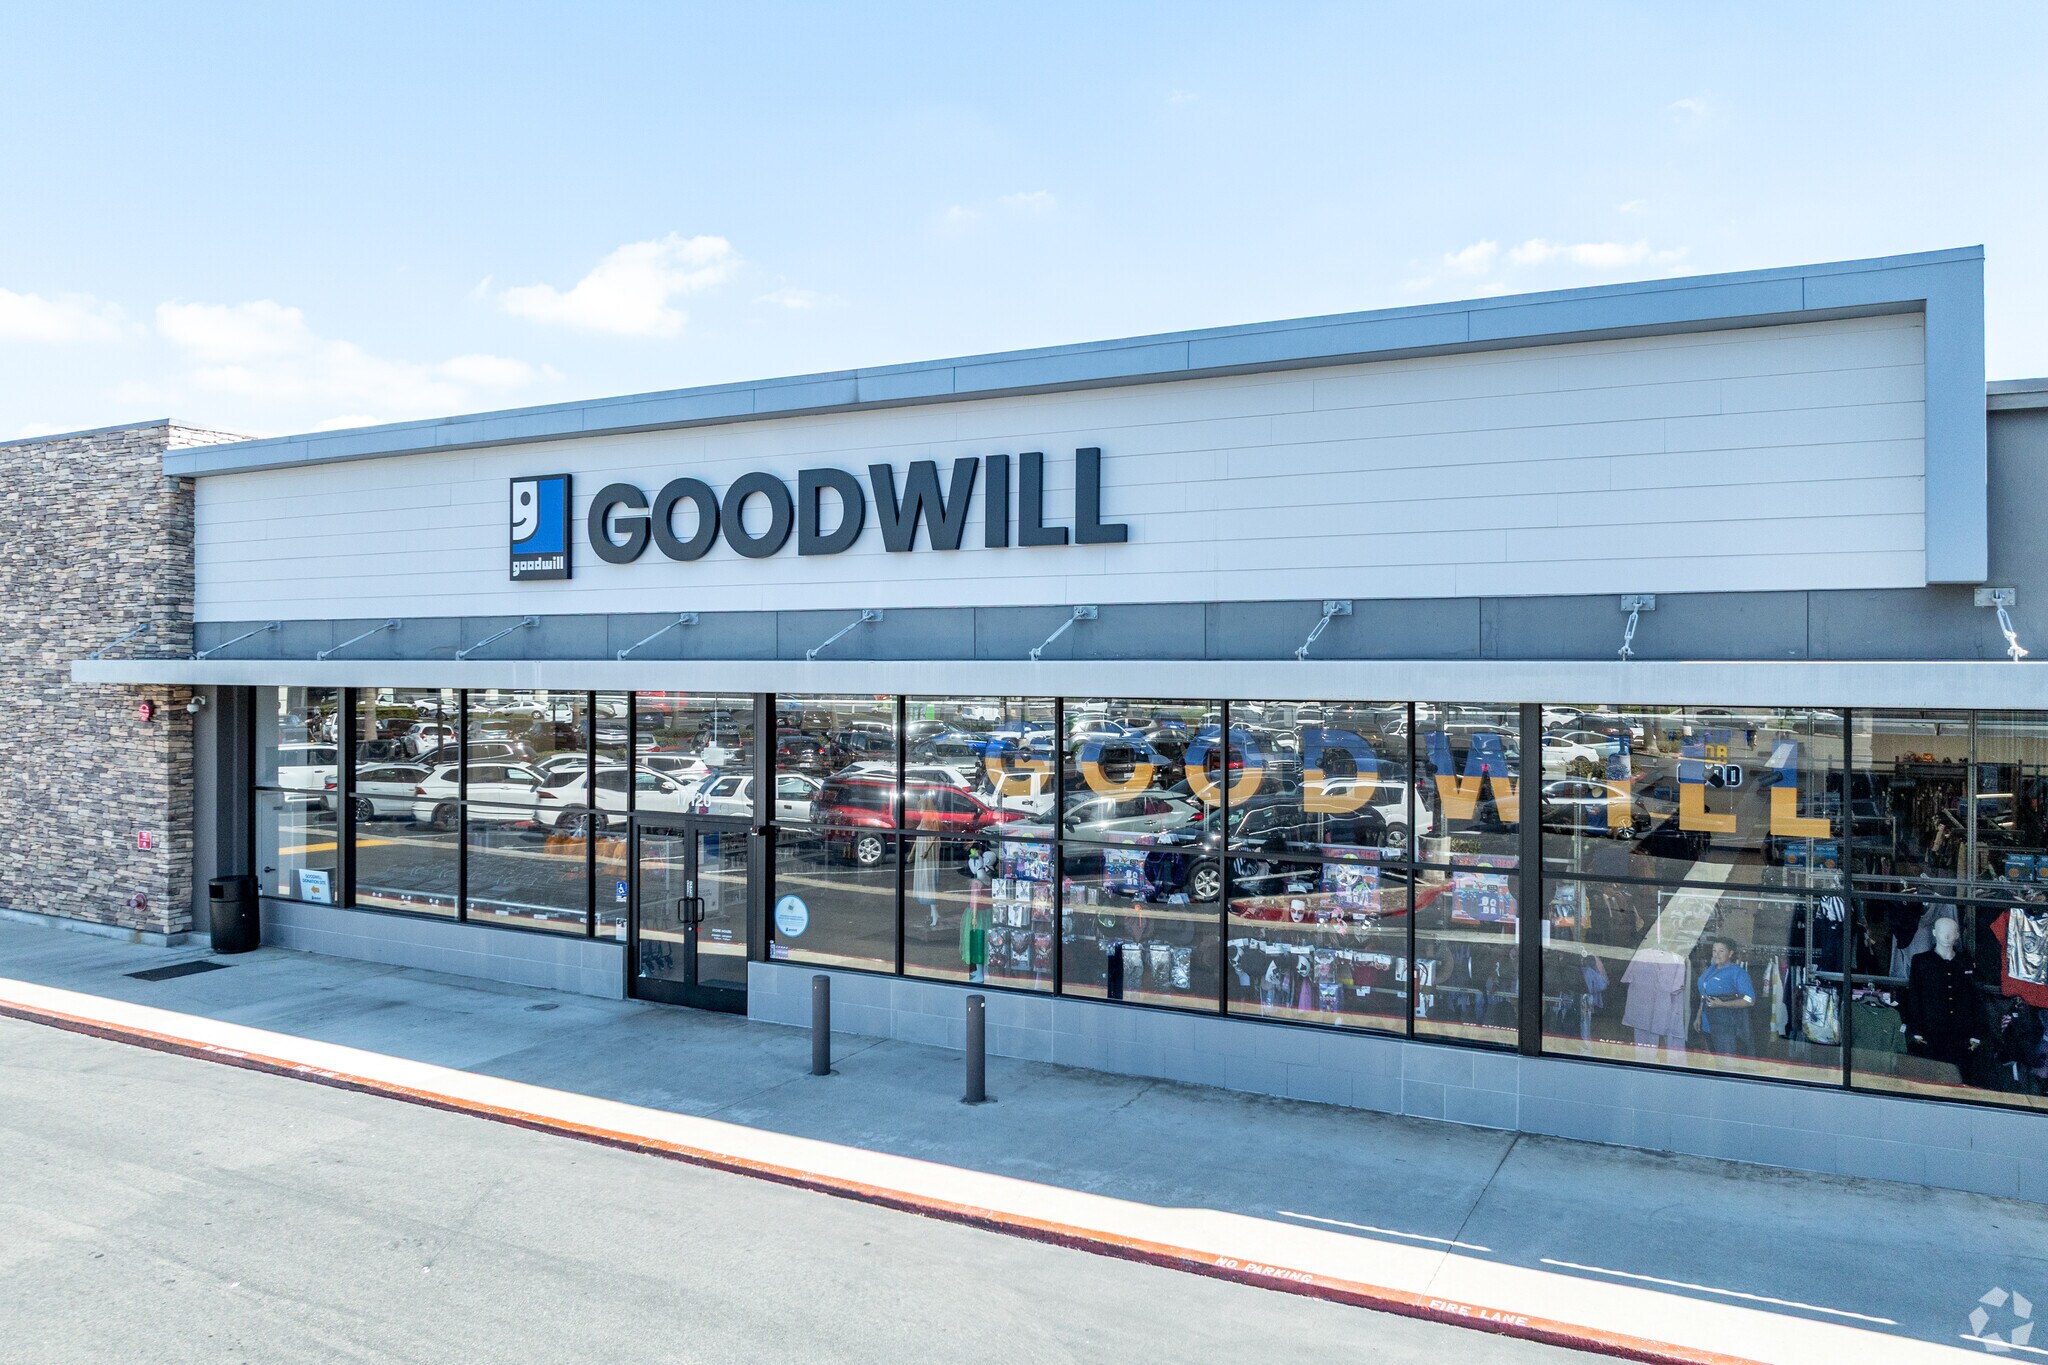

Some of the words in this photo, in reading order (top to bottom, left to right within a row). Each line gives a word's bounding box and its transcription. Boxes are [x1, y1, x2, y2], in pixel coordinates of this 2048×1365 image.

[588, 447, 1128, 564] GOODWILL
[512, 555, 564, 577] goodwill
[984, 721, 1831, 839] GOODWILL
[1214, 1256, 1237, 1269] NO
[1244, 1262, 1314, 1284] PARKING
[1428, 1299, 1471, 1317] FIRE
[1480, 1308, 1530, 1327] LANE
